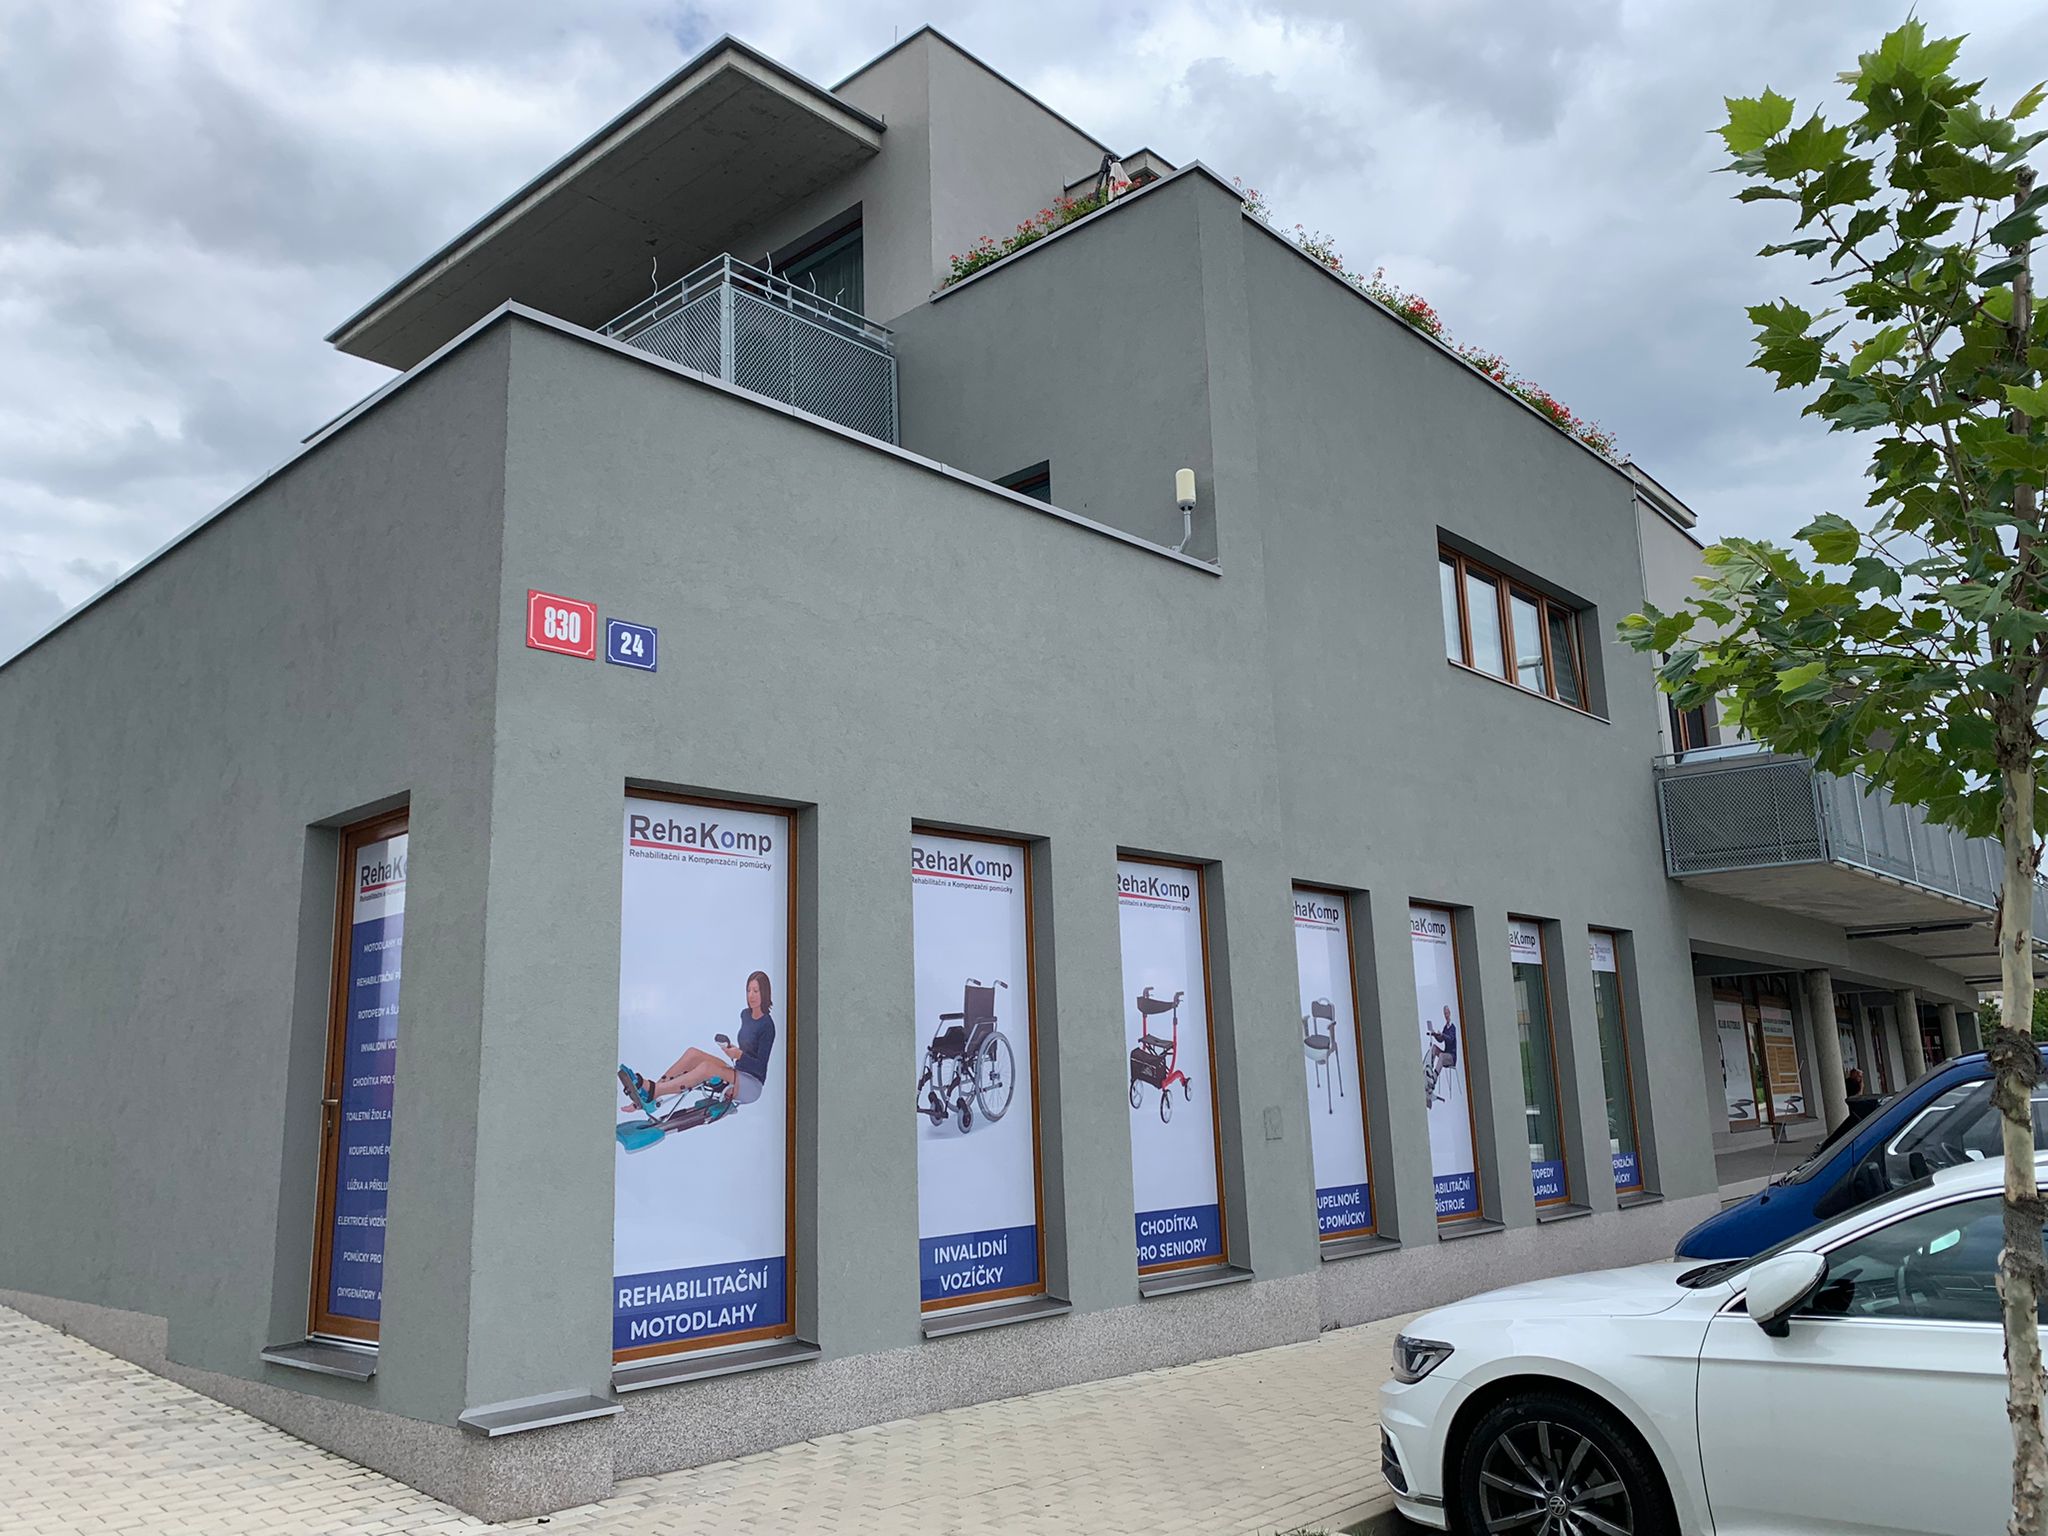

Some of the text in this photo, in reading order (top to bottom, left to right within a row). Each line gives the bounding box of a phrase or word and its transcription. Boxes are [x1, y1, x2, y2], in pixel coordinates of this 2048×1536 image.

[544, 606, 581, 644] 830
[620, 631, 644, 658] 24
[630, 814, 772, 856] RehaKomp
[629, 848, 680, 862] Rehabilitační
[688, 855, 738, 868] Kompenzační
[912, 847, 1013, 881] RehaKomp
[380, 1074, 391, 1085] PRO
[387, 1110, 392, 1119] A
[364, 1181, 368, 1190] A
[1140, 1213, 1199, 1236] CHODÍTKA
[1326, 1209, 1365, 1229] POMŮCKY
[370, 1253, 382, 1264] PRO
[934, 1233, 1008, 1265] INVALIDNÍ
[1159, 1237, 1207, 1258] SENIORY
[618, 1265, 769, 1309] REHABILITAČNÍ
[940, 1264, 1004, 1292] VOZÍČKY
[630, 1303, 758, 1341] MOTODLAHY
